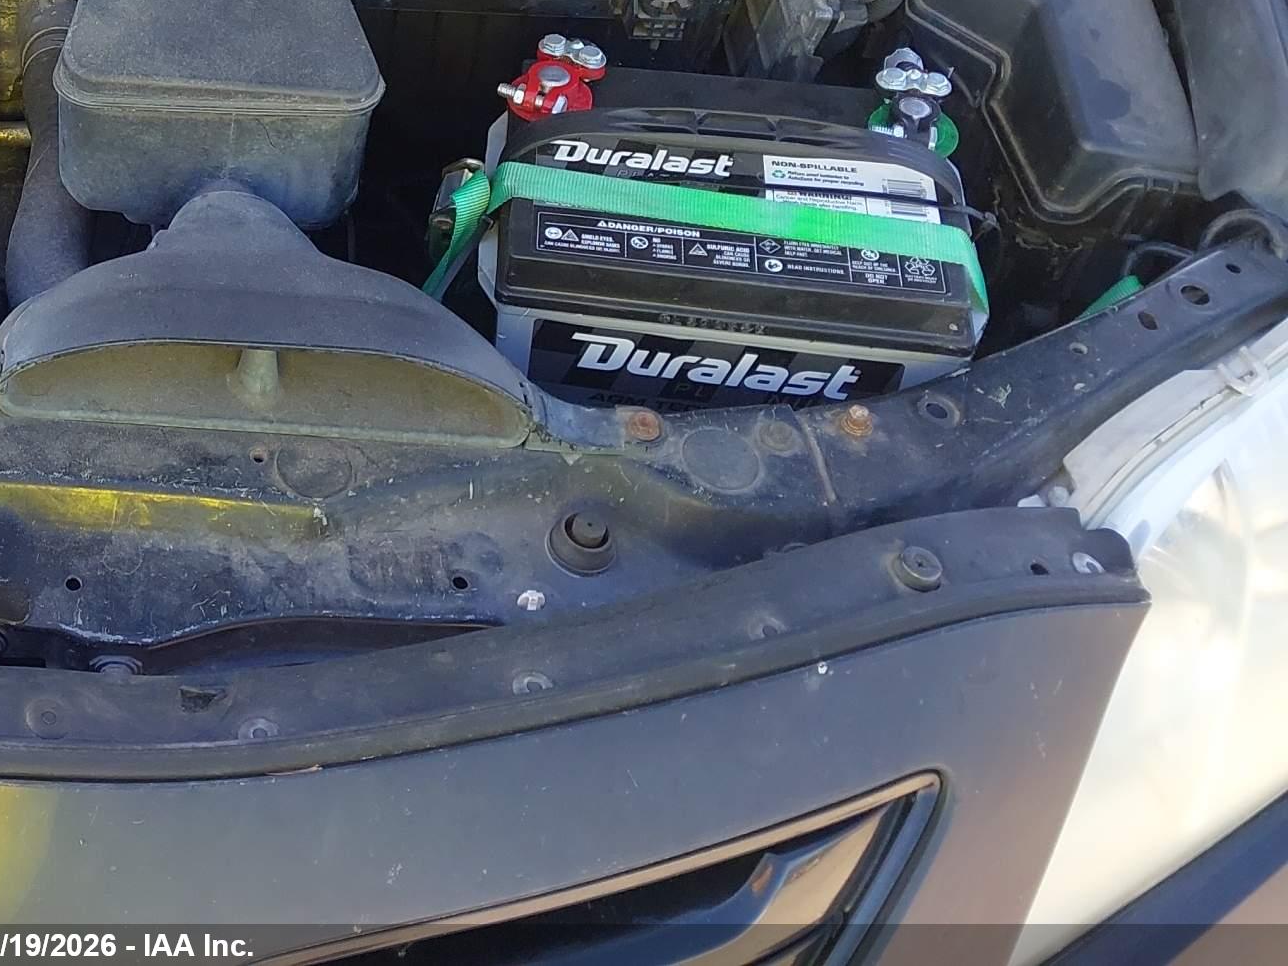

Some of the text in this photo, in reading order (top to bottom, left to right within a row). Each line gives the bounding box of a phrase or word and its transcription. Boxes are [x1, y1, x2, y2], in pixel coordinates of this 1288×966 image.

[550, 140, 734, 177] Duralast
[771, 161, 857, 173] NON-SPILLABLE
[607, 221, 700, 238] DANGER/POISON
[572, 332, 860, 401] Duralast
